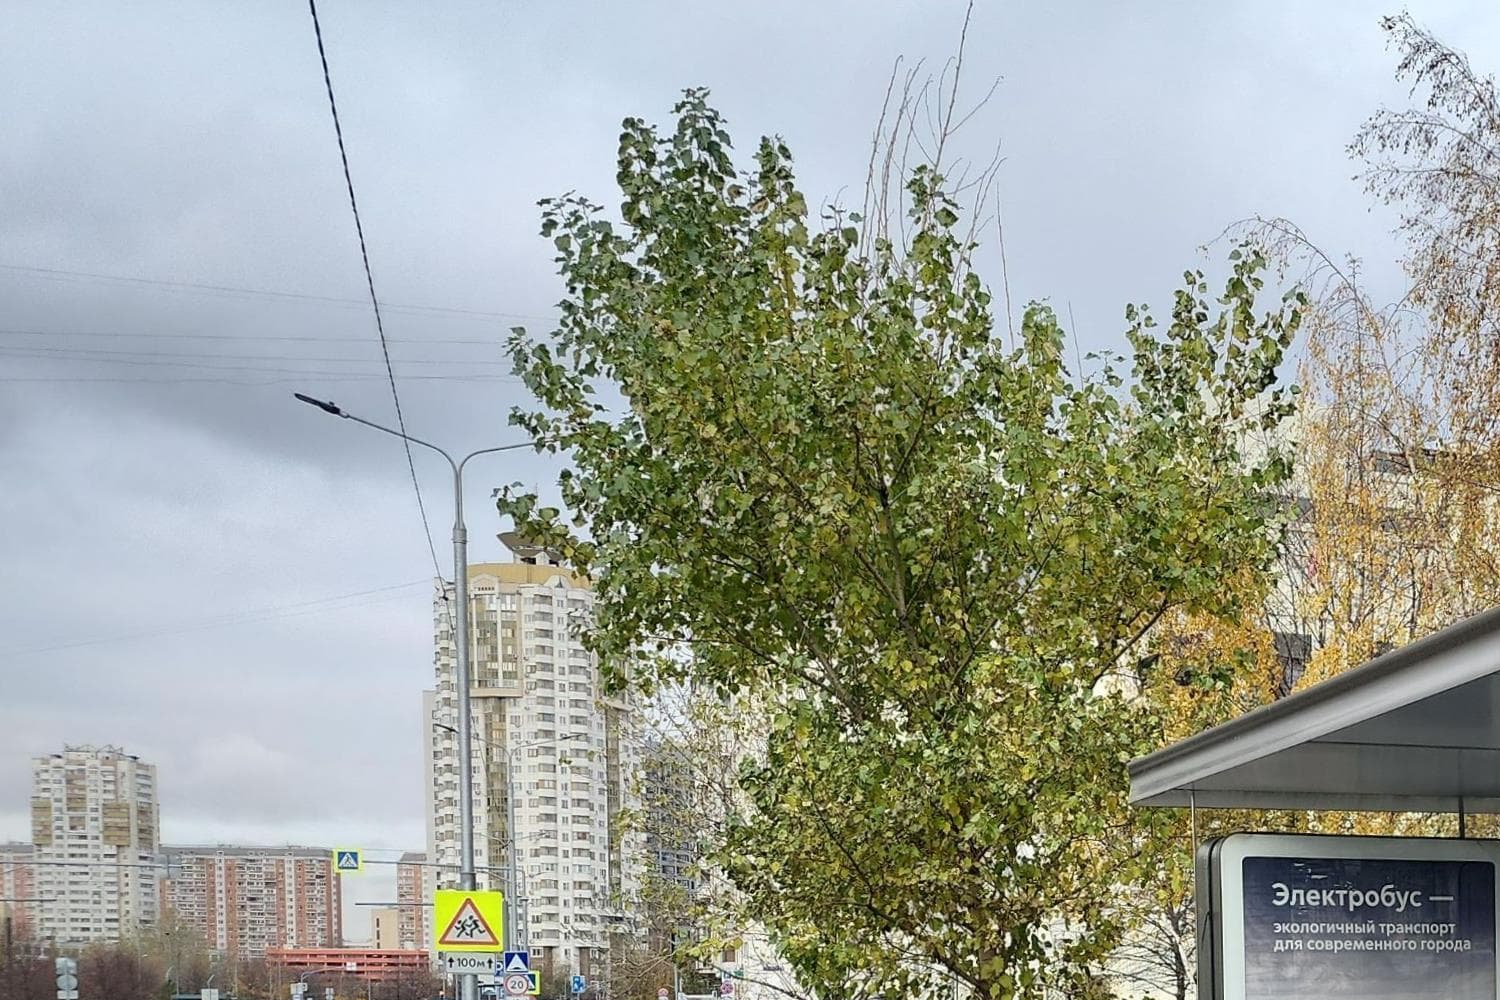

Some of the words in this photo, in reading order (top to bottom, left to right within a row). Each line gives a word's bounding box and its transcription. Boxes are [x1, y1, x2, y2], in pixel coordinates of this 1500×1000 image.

[1271, 882, 1422, 912] Электробус
[1273, 920, 1375, 934] экологичный
[1378, 922, 1456, 936] транспорт
[1273, 938, 1303, 952] для
[1306, 939, 1417, 953] современного
[1420, 938, 1472, 953] города
[510, 980, 524, 989] 20
